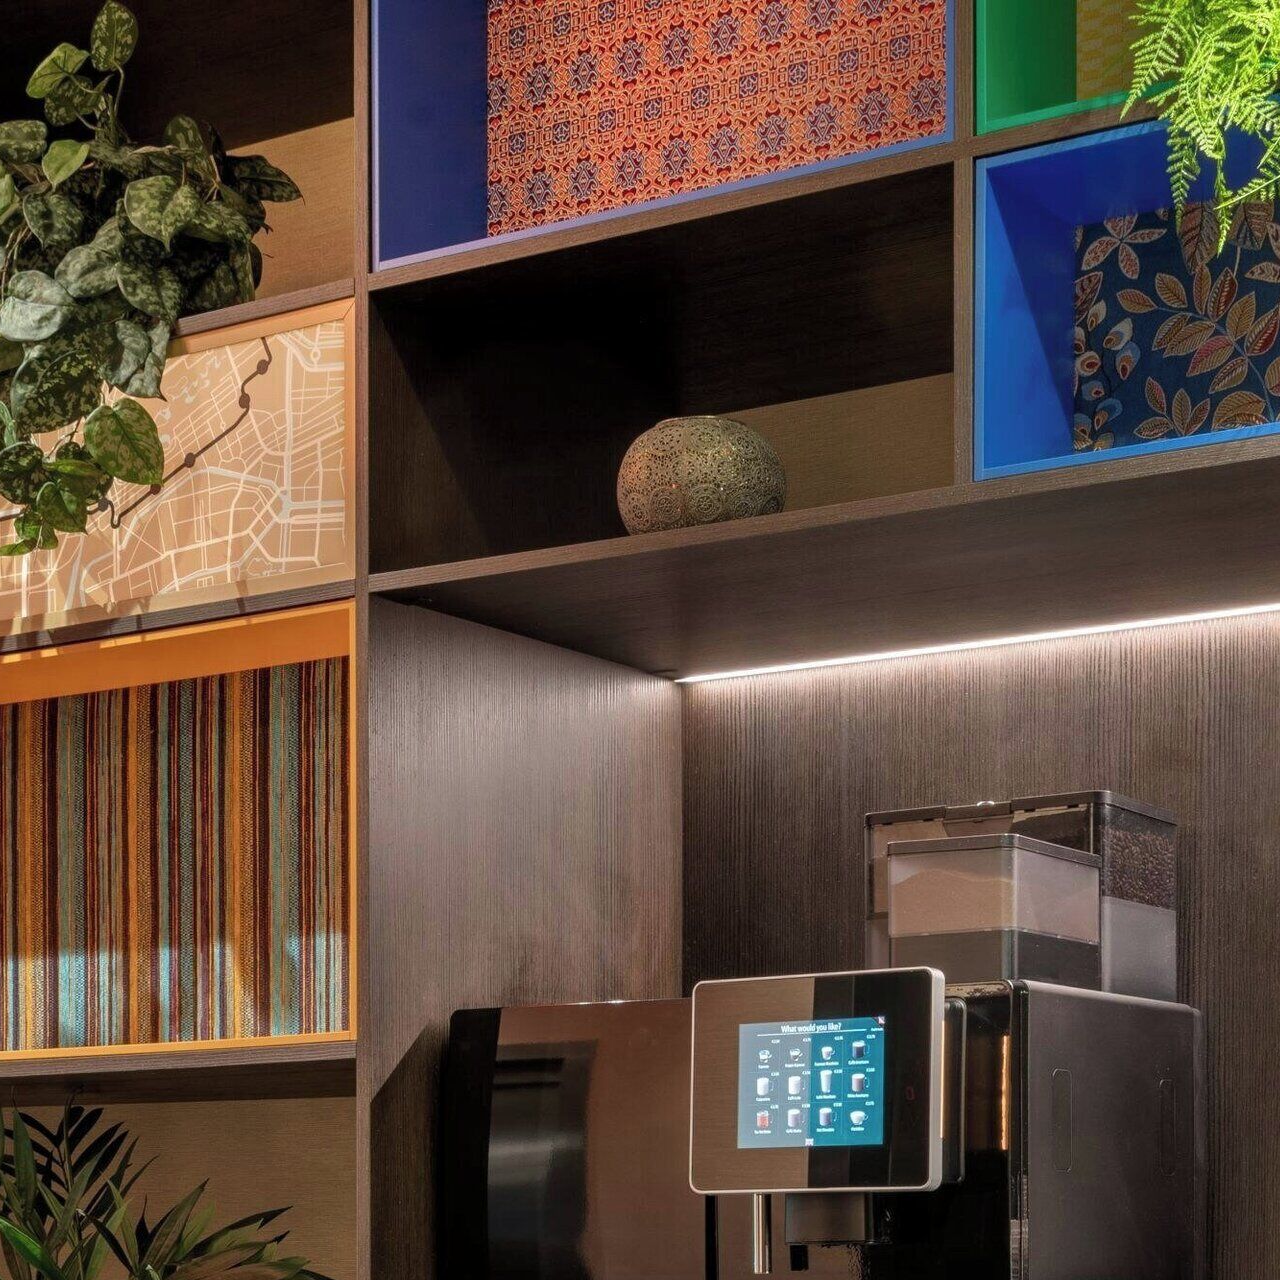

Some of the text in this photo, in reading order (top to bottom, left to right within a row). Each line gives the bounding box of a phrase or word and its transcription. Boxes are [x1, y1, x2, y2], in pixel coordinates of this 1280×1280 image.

[781, 1022, 841, 1034] What would you like?
